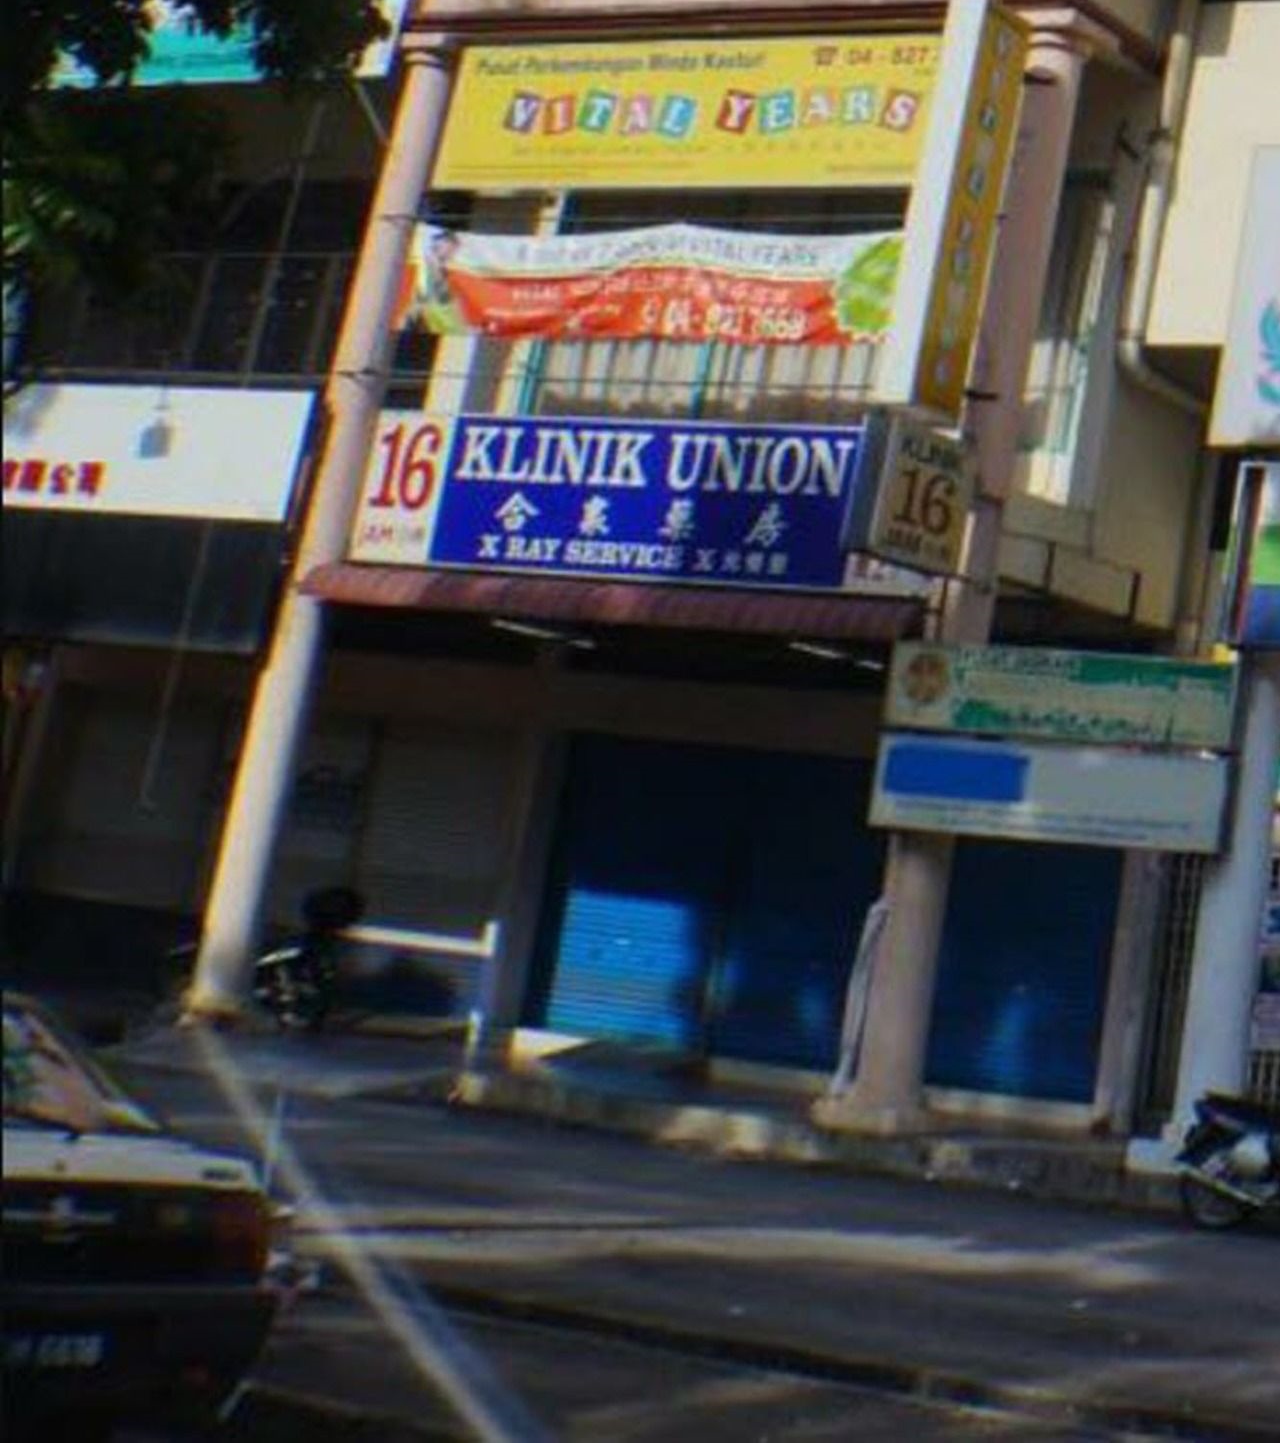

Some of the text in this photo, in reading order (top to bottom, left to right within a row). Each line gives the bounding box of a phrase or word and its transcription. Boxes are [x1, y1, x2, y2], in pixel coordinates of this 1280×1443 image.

[506, 87, 919, 134] VITAL YEARS
[369, 424, 441, 511] 16
[455, 425, 854, 496] KLINIK UNION
[893, 470, 954, 536] 16
[477, 534, 684, 569] X RAY SERVICE
